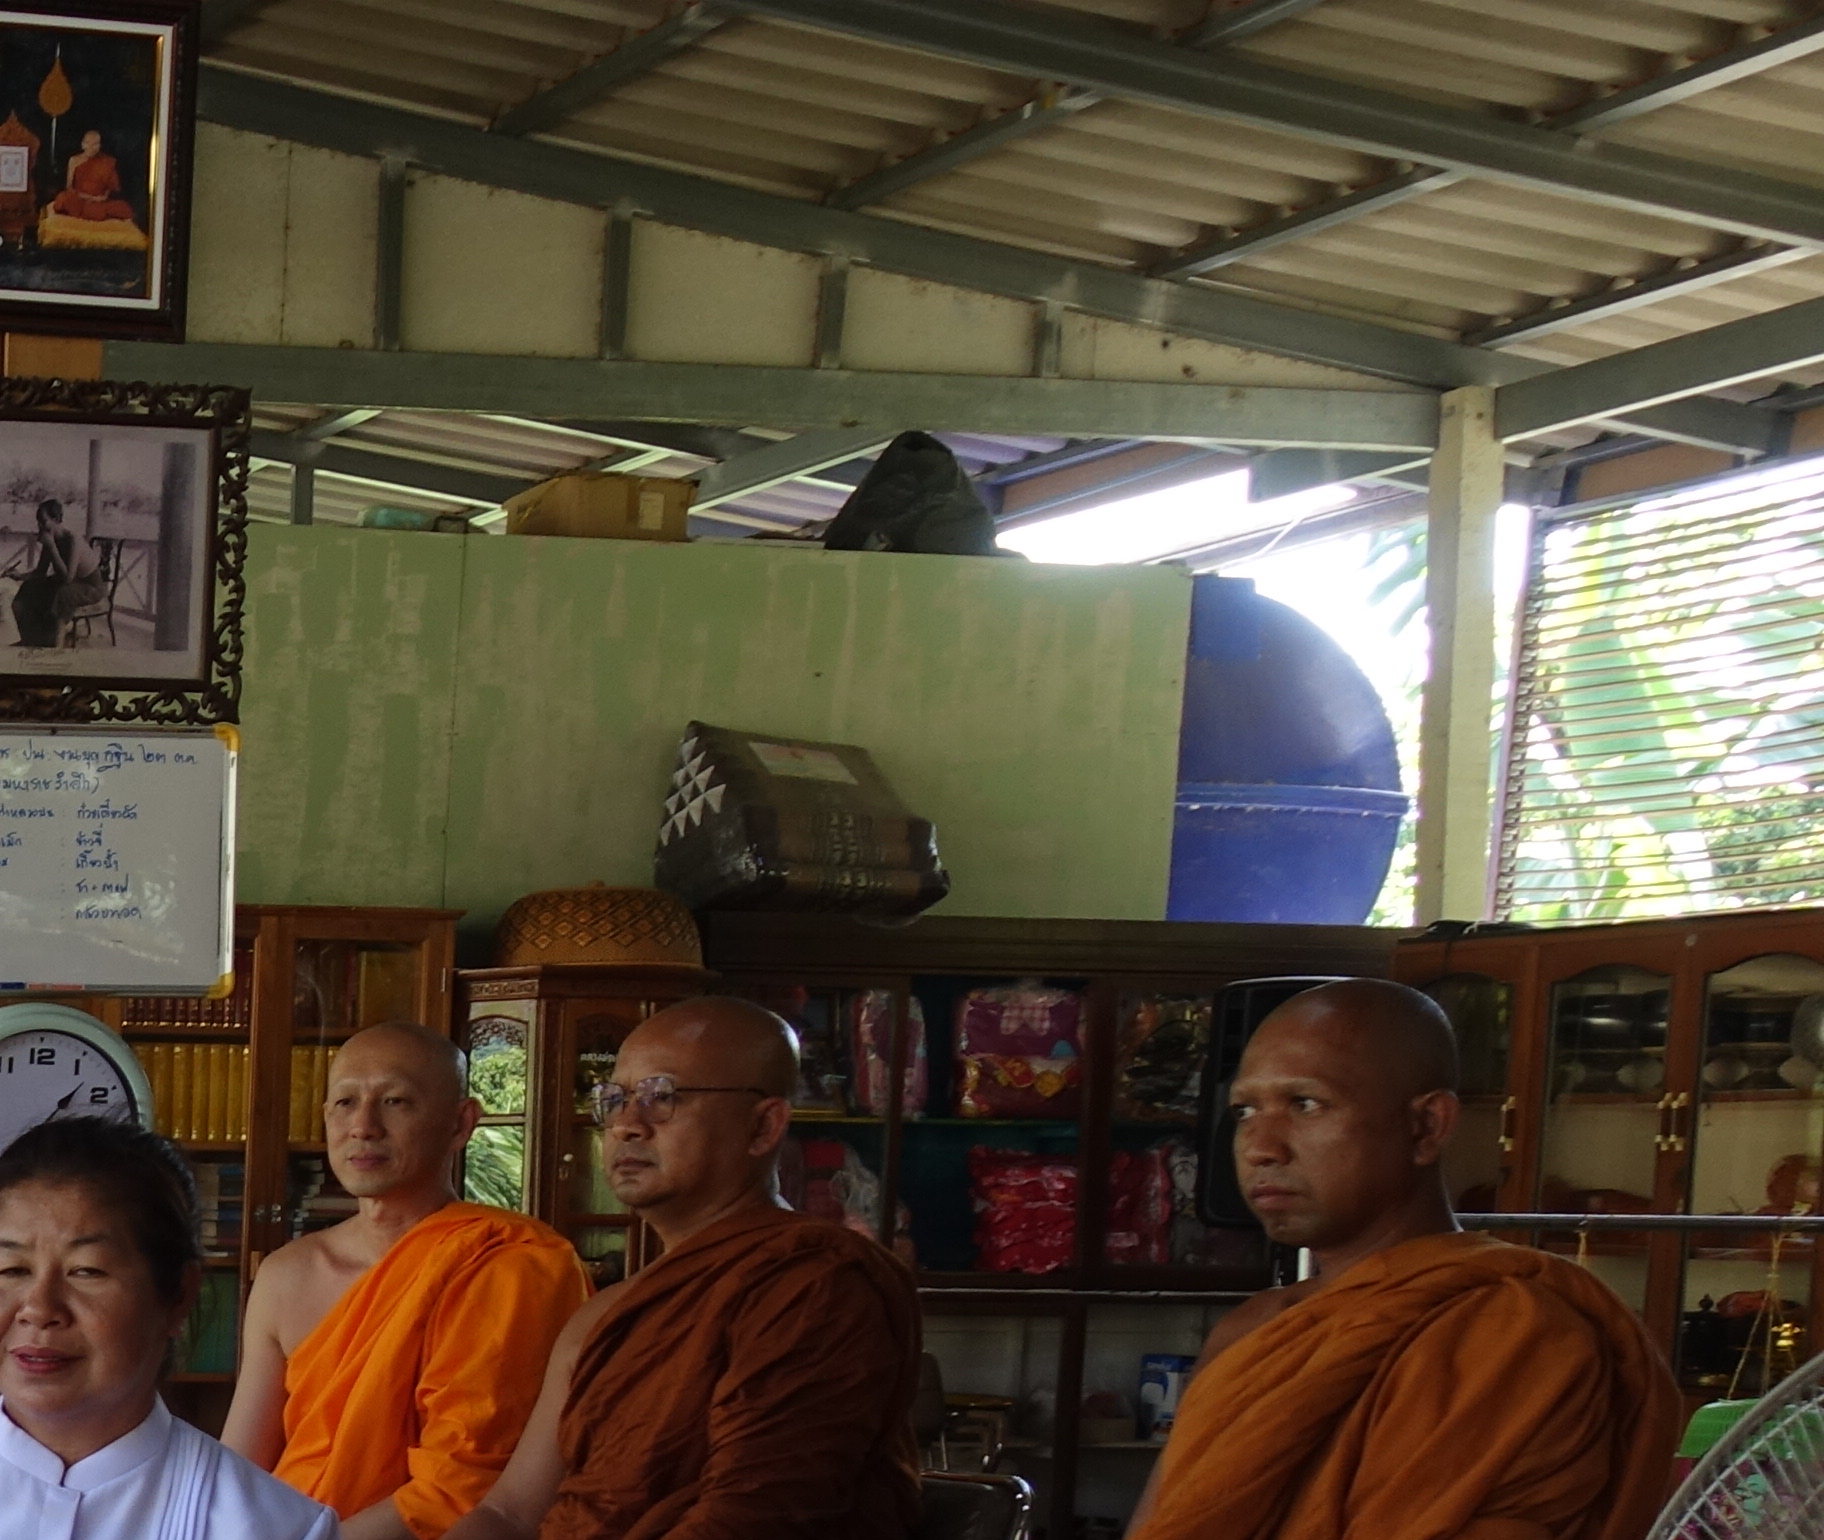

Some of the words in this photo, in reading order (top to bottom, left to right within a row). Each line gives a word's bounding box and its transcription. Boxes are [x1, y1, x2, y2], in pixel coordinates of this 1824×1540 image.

[28, 1046, 56, 1066] 12
[73, 1058, 81, 1076] 1
[89, 1086, 109, 1104] 2
